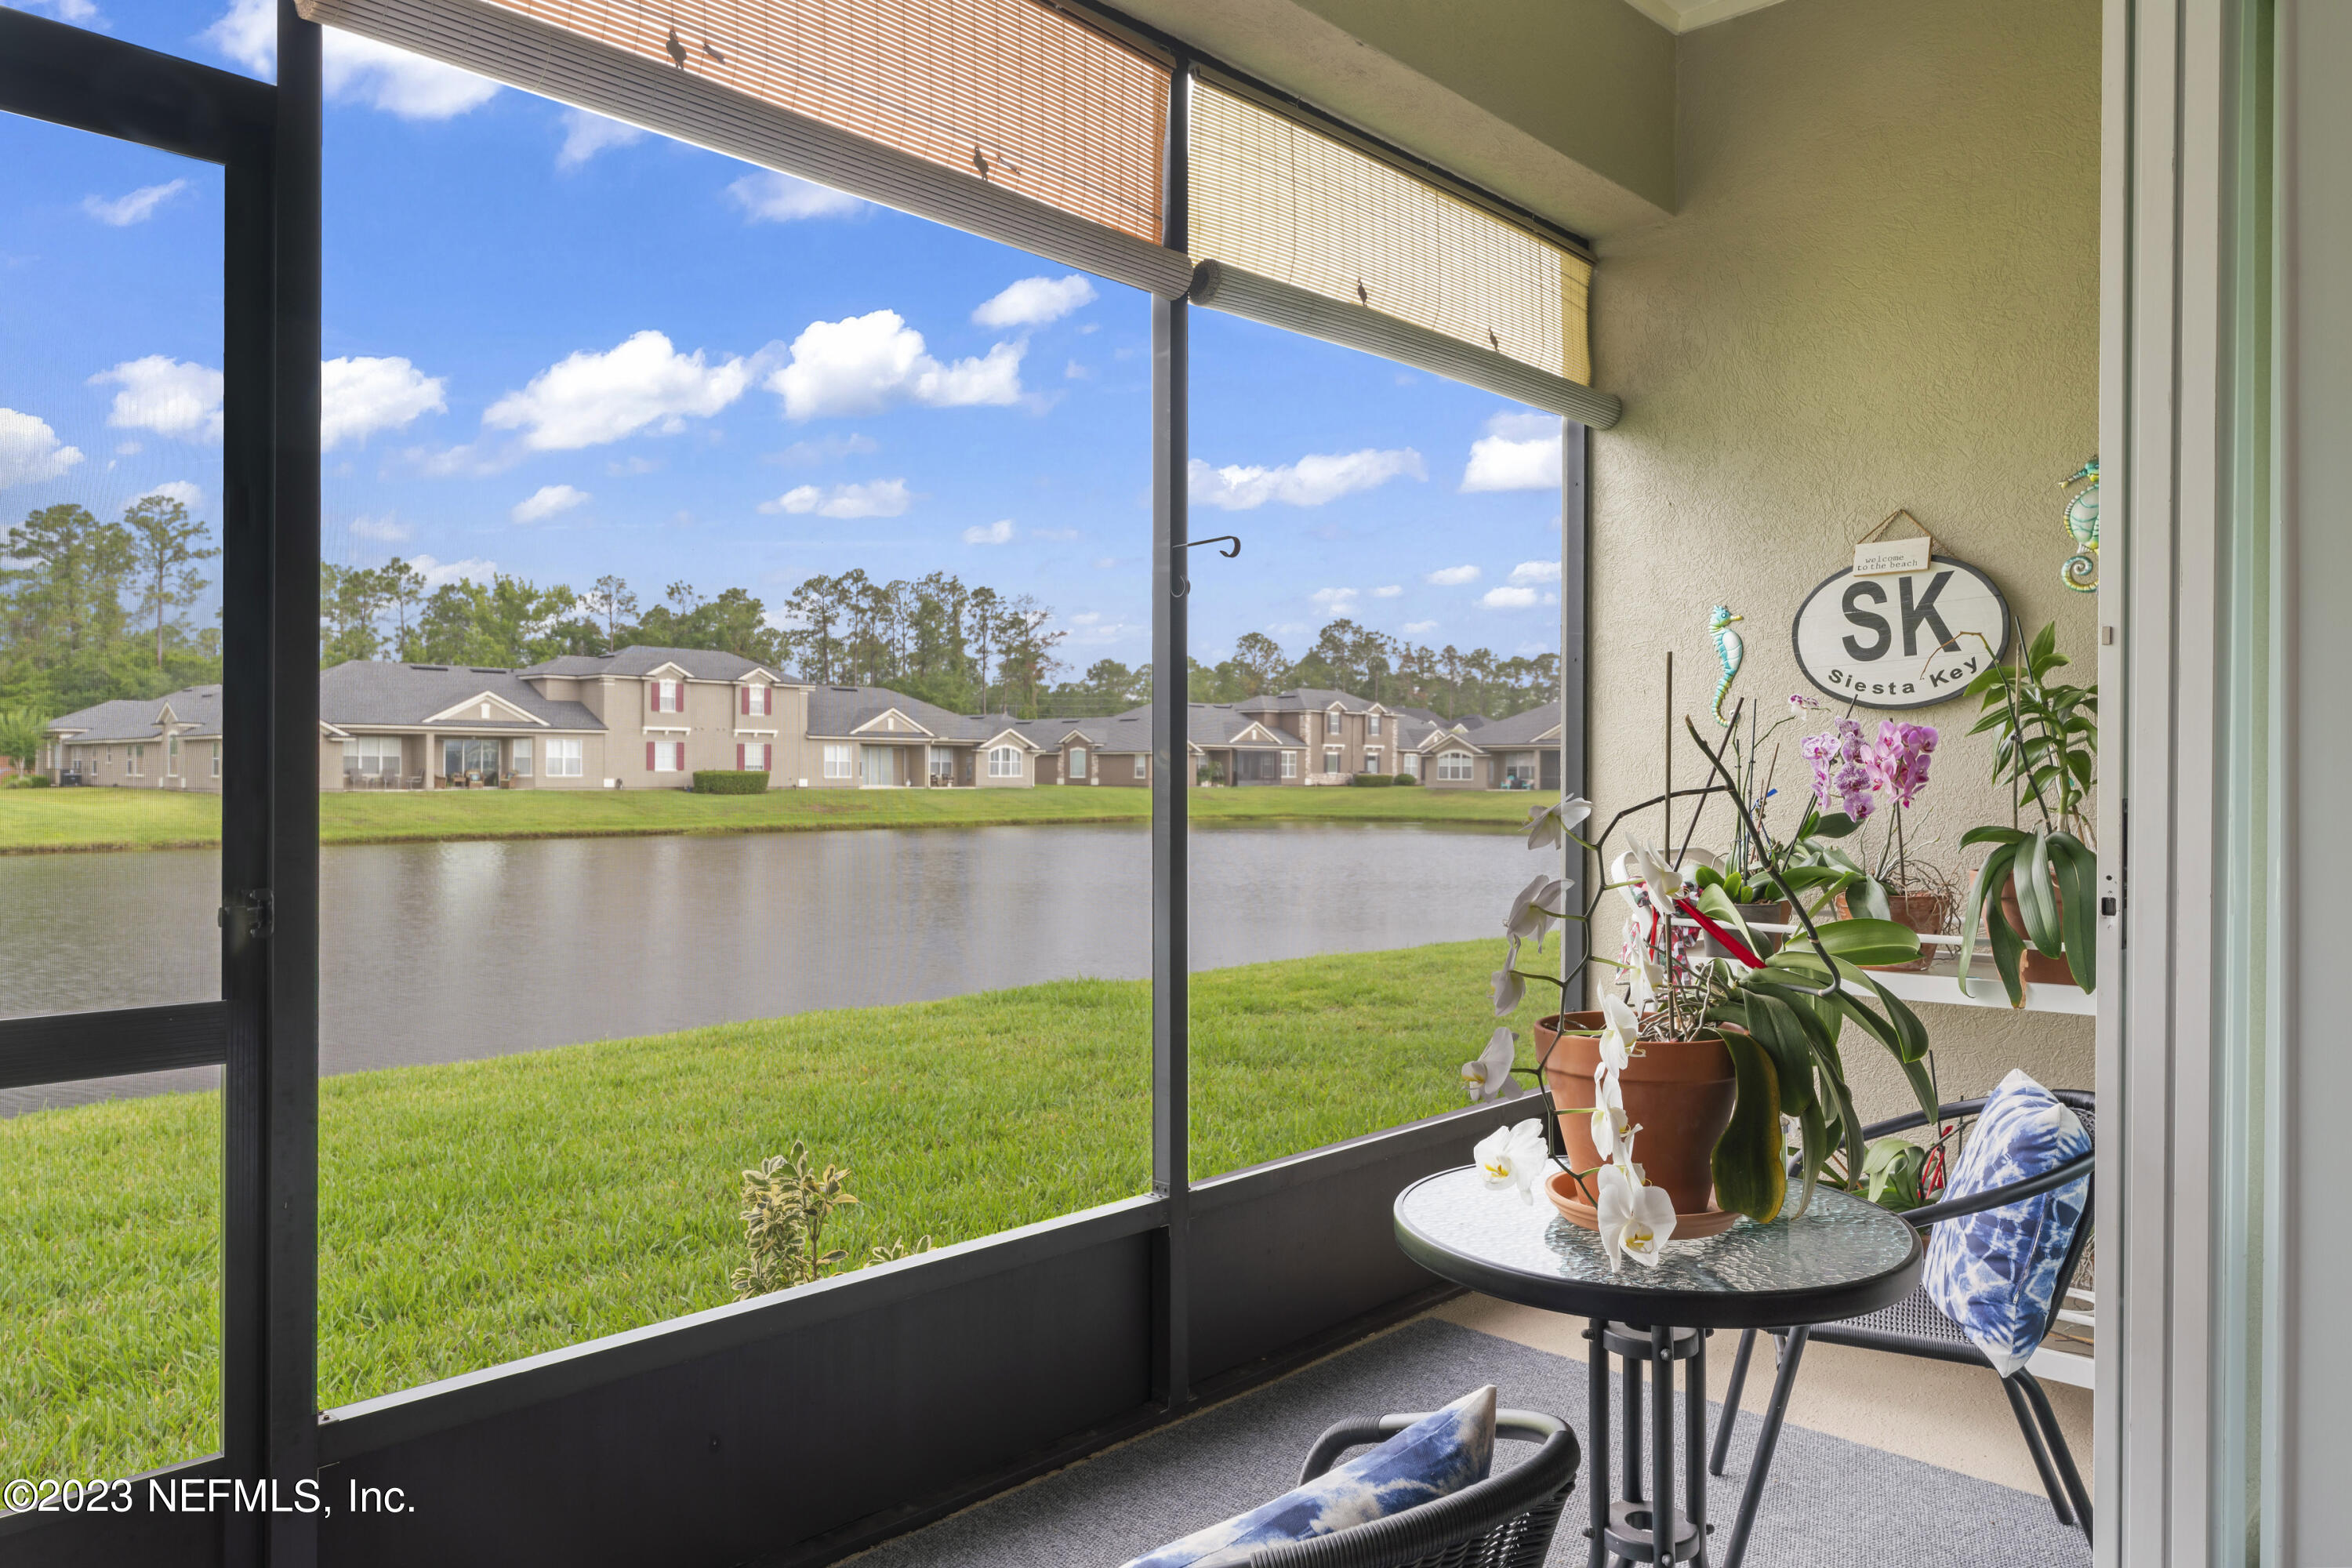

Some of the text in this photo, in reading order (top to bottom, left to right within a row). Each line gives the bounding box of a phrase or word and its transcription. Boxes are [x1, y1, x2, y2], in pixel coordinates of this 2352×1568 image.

[1865, 554, 1904, 564] welcome
[1890, 559, 1918, 568] beach
[1842, 570, 1962, 662] SK
[1828, 656, 1979, 695] Siesta Key
